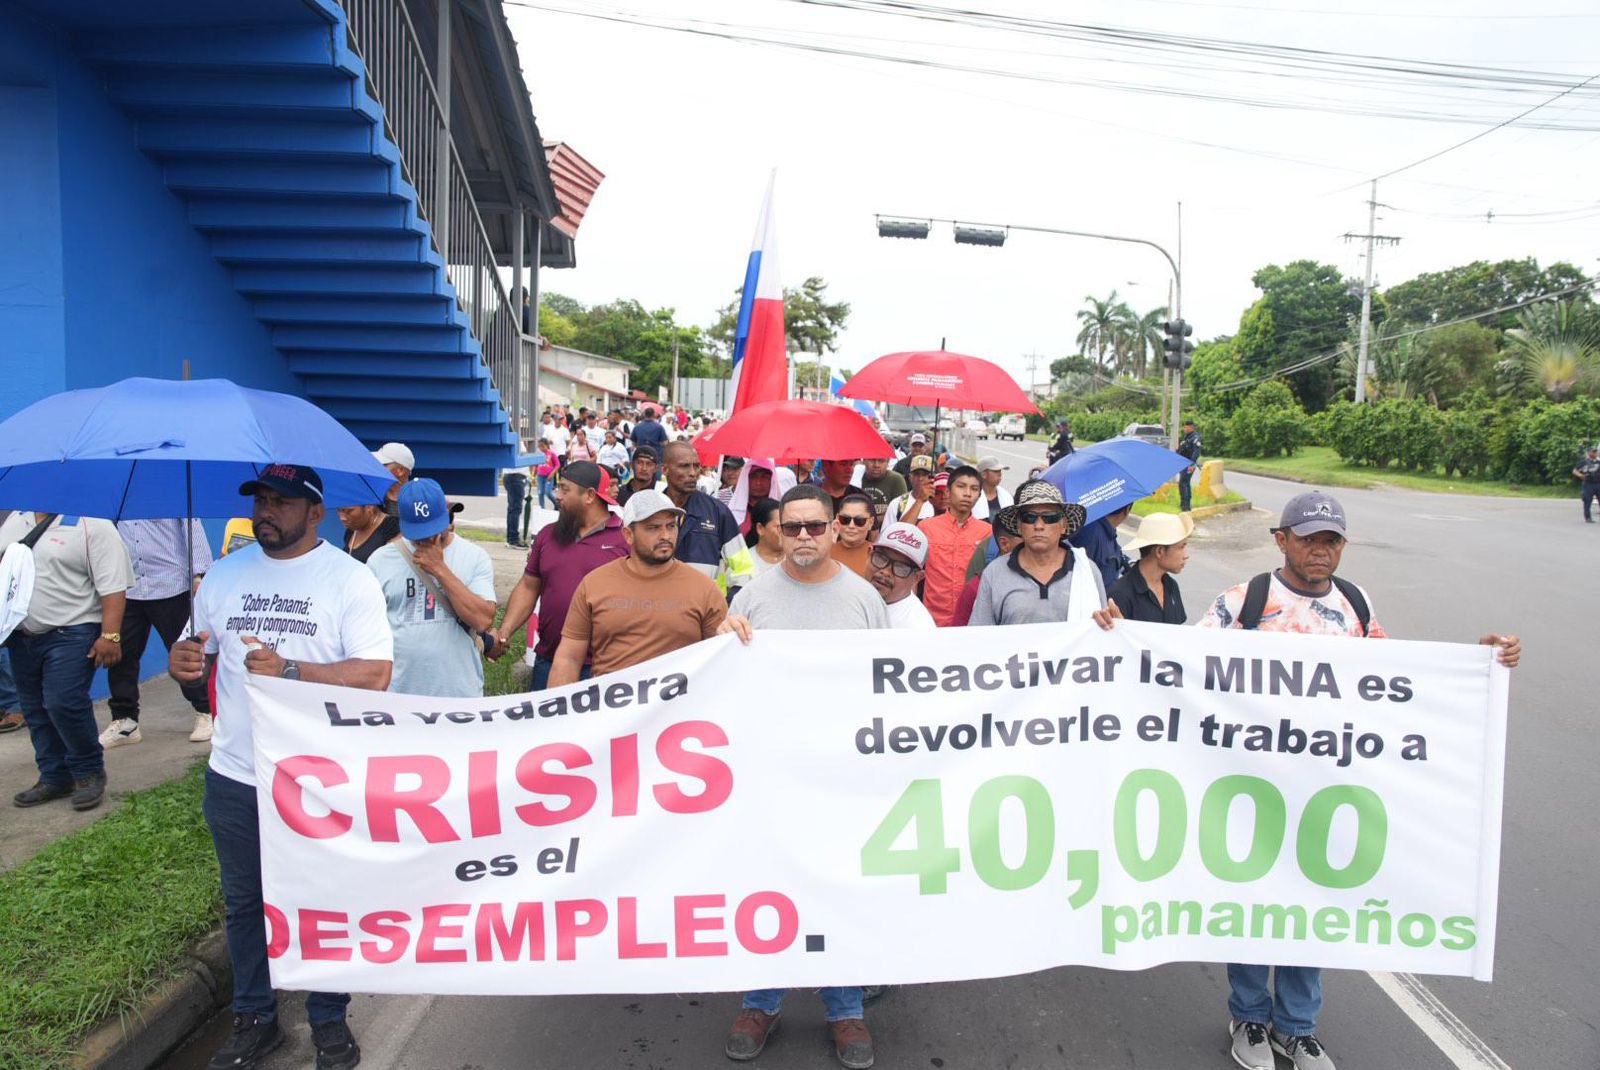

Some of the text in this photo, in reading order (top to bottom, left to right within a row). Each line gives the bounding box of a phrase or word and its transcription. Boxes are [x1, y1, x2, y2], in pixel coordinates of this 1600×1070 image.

[414, 501, 430, 518] KC
[886, 530, 922, 550] Cobre
[226, 613, 318, 637] empleo y compromiso
[269, 593, 313, 616] Panamá:
[324, 672, 689, 727] La verdadera
[872, 650, 1414, 703] Reactivar la MINA es
[855, 706, 1428, 768] devolverle el trabajo a
[272, 720, 734, 844] CRISIS
[455, 837, 580, 882] es el
[861, 768, 1388, 910] 40,000
[1101, 898, 1478, 955] panameños
